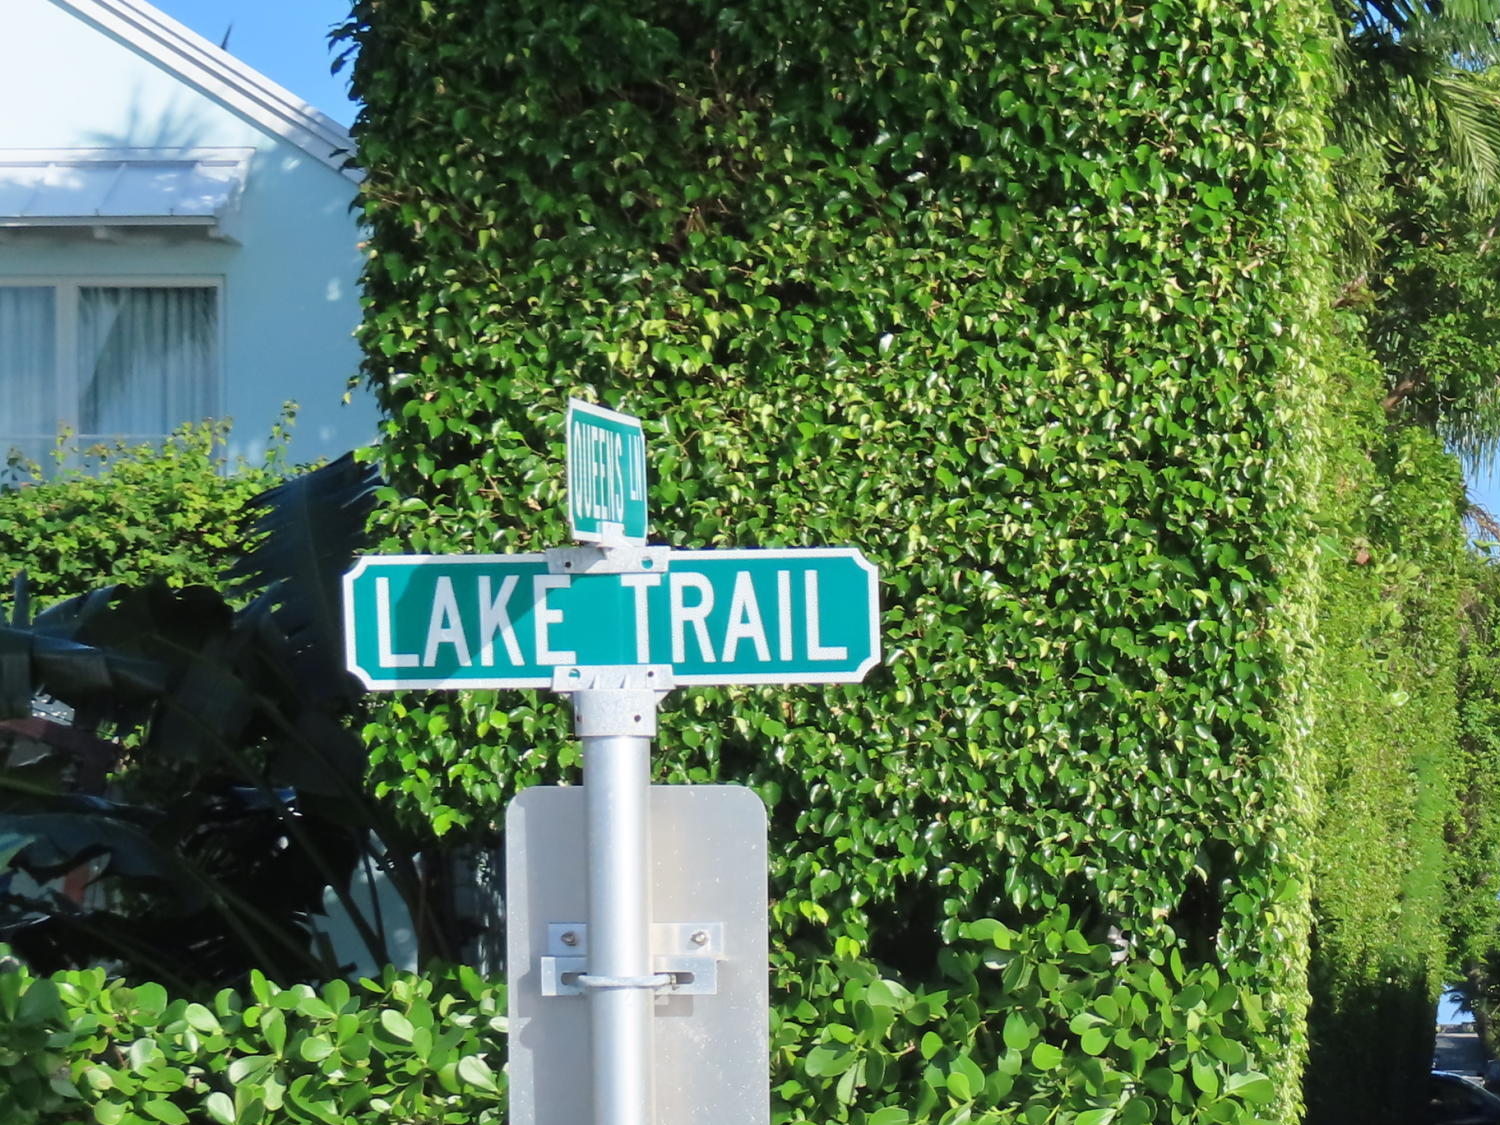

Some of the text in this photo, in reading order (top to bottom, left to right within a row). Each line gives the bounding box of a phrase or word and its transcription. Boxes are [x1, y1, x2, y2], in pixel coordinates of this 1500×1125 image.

[574, 421, 644, 522] QUEENS LN
[375, 570, 849, 668] LAKE TRAIL
